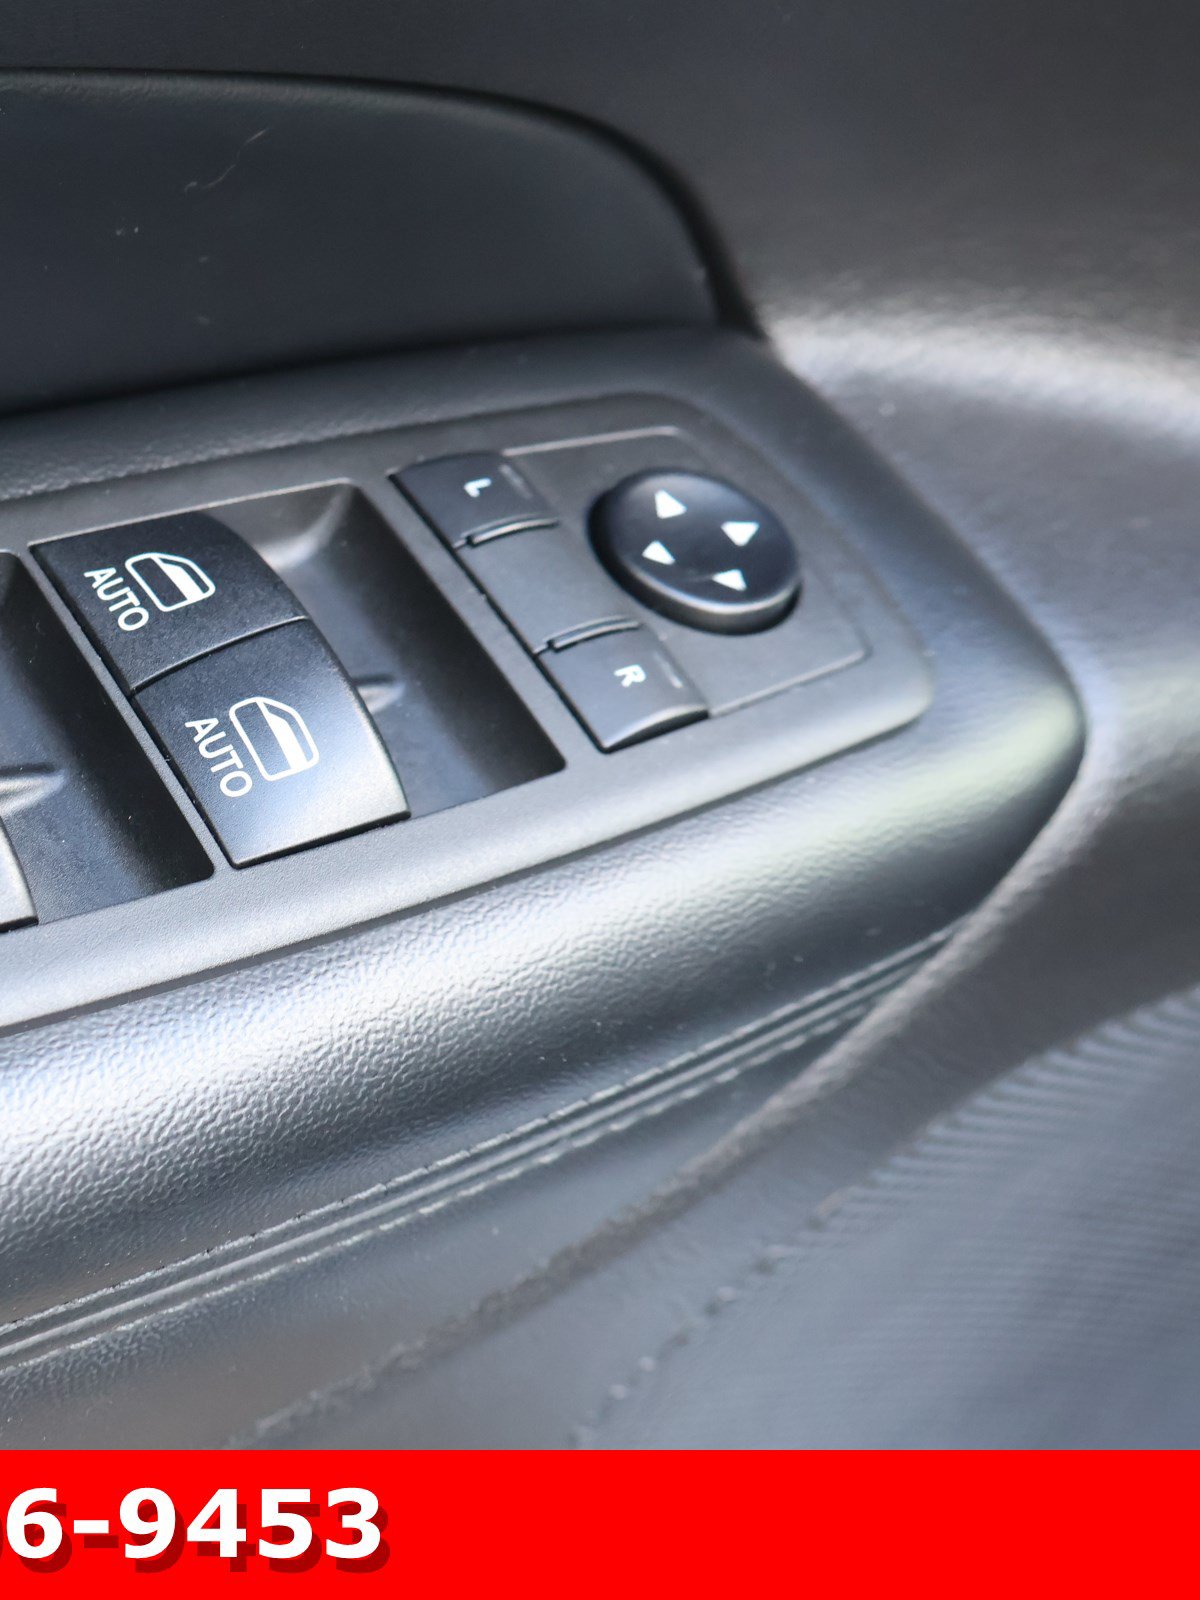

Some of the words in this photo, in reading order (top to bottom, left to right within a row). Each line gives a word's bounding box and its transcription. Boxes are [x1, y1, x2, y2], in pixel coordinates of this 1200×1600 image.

[463, 477, 492, 498] L
[83, 567, 150, 632] AUTO
[613, 663, 647, 688] R
[185, 717, 253, 798] AUTO
